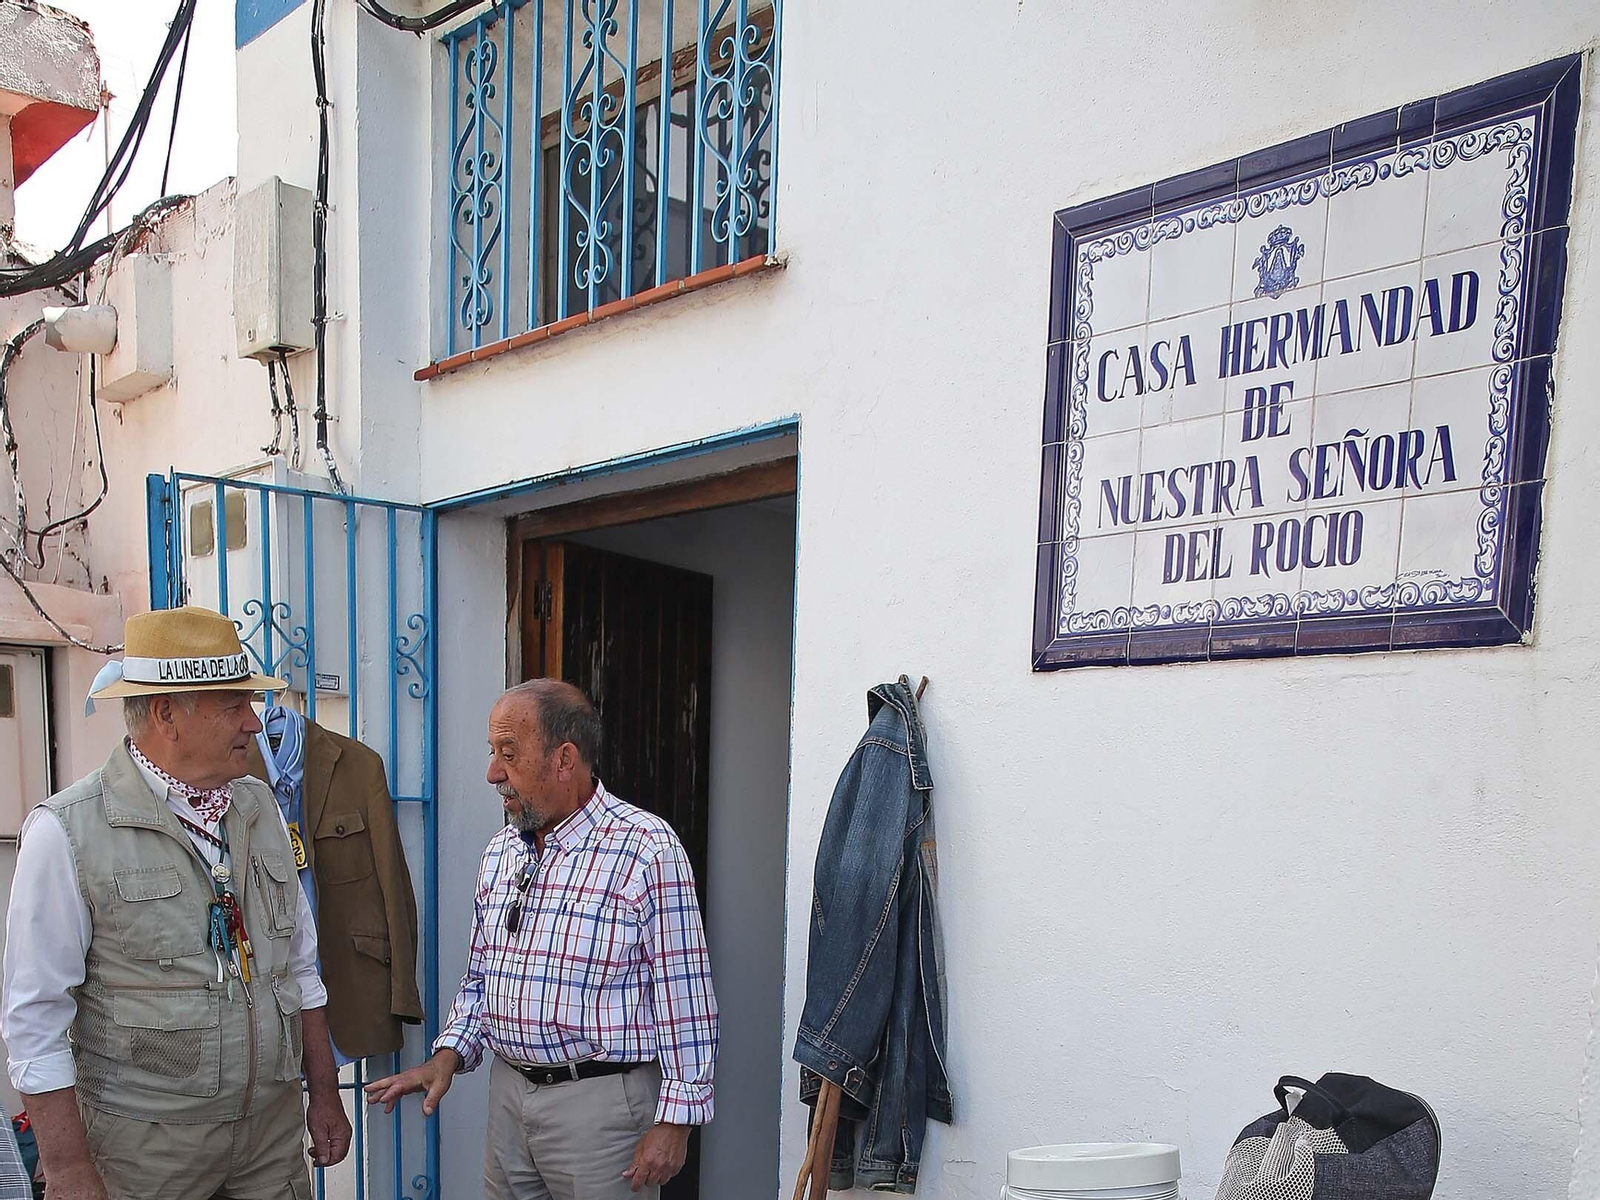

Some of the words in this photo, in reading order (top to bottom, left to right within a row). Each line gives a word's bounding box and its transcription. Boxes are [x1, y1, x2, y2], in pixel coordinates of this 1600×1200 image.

[1099, 335, 1197, 403] CASA
[1218, 270, 1479, 380] HERMANDAD
[1241, 381, 1294, 442] DE
[1098, 456, 1264, 529] NUESTRA
[1287, 425, 1457, 504] SEÑORA
[1162, 528, 1233, 585] DEL
[1250, 509, 1364, 579] ROCIO
[158, 661, 174, 680] LA
[175, 659, 208, 680] LINEA
[209, 658, 226, 678] DE
[226, 656, 240, 677] LA
